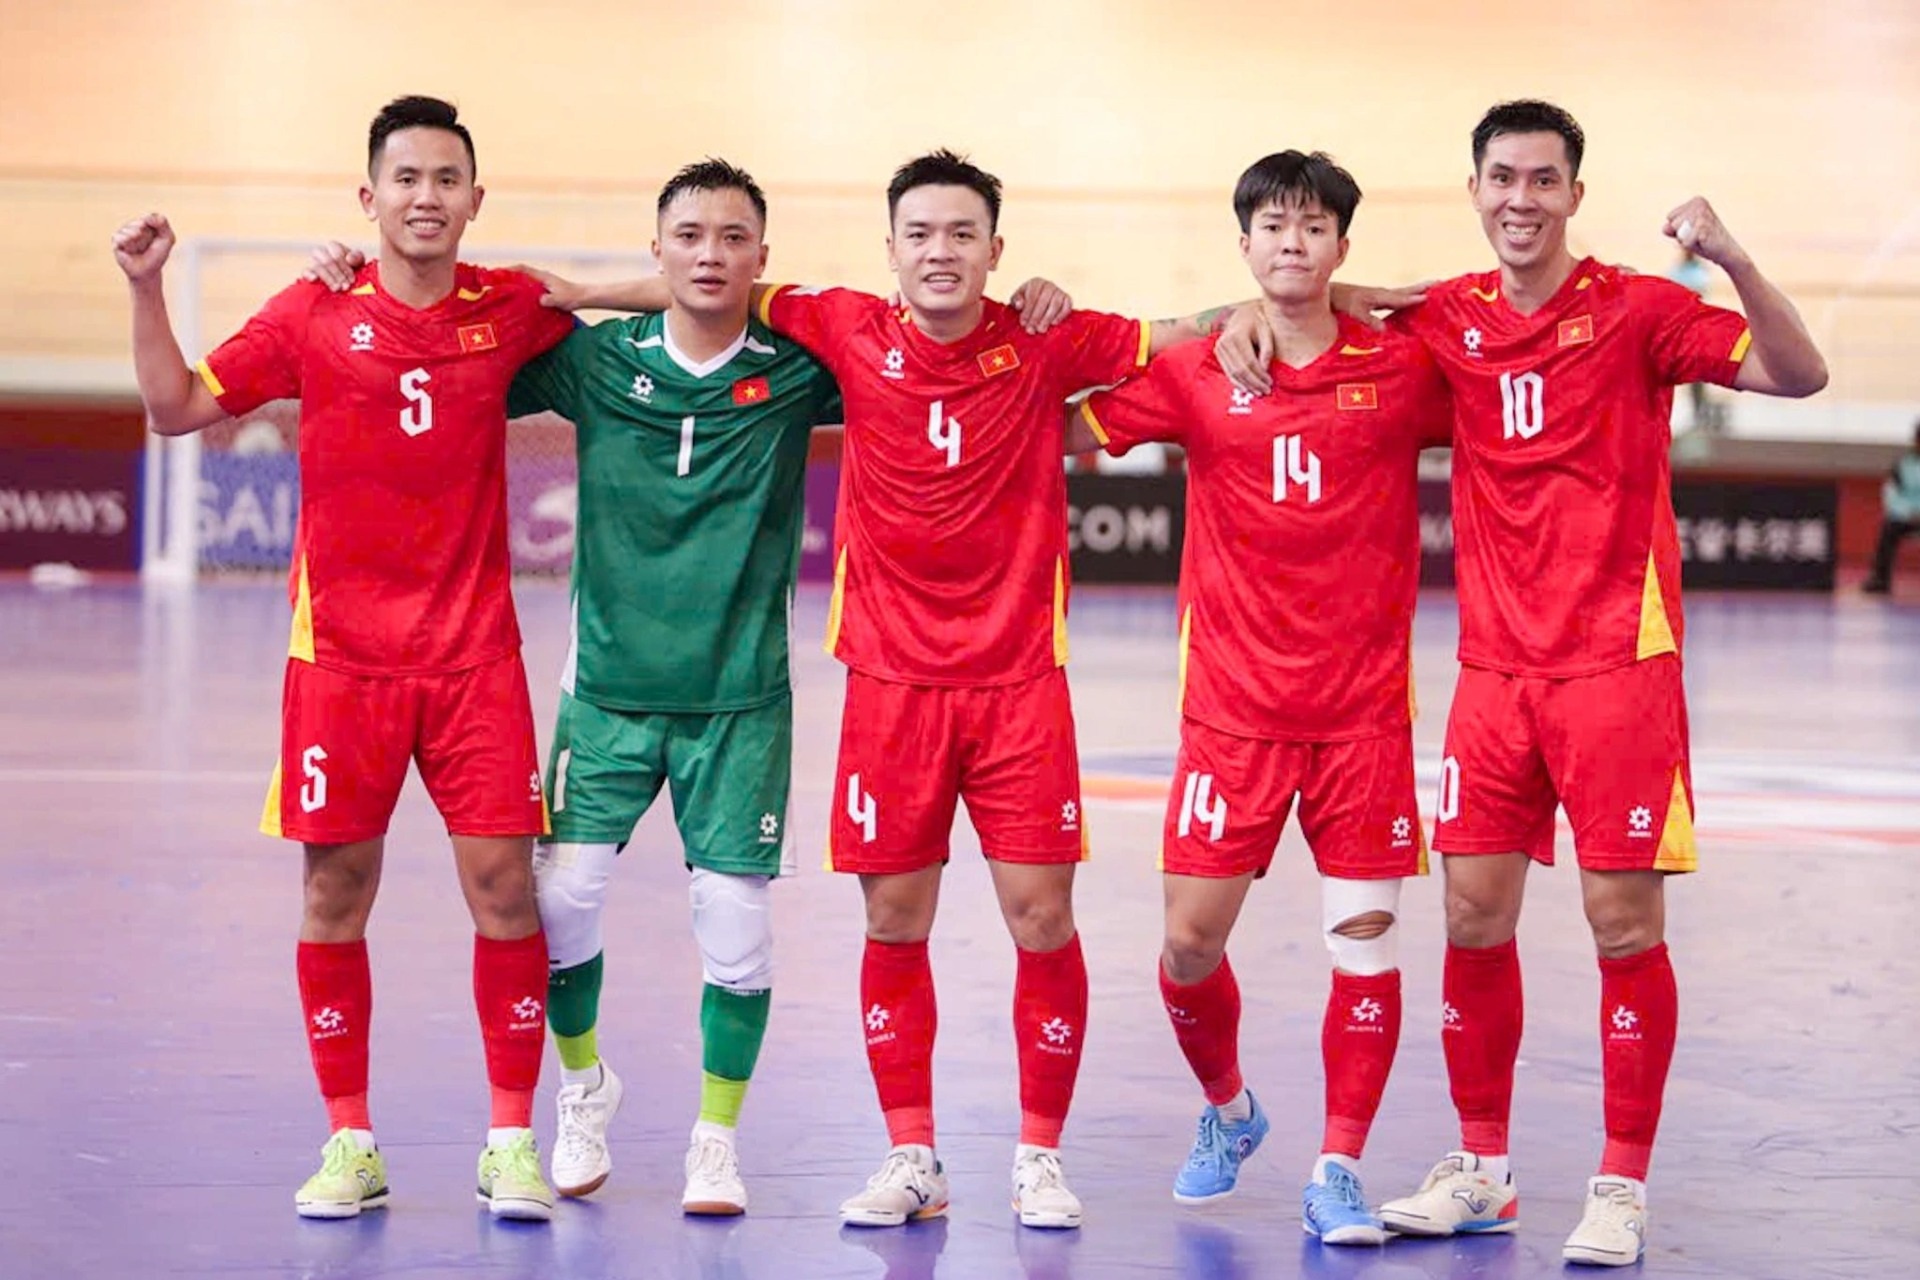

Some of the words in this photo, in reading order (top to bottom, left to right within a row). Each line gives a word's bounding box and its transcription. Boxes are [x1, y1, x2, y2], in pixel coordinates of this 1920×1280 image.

[928, 400, 962, 467] 4
[1499, 371, 1543, 440] 10
[677, 415, 695, 477] 1
[1272, 434, 1322, 504] 14
[0, 488, 127, 535] WAYS
[553, 748, 571, 813] 1
[847, 772, 877, 842] 4
[1178, 771, 1228, 843] 14
[1438, 755, 1461, 824] 0
